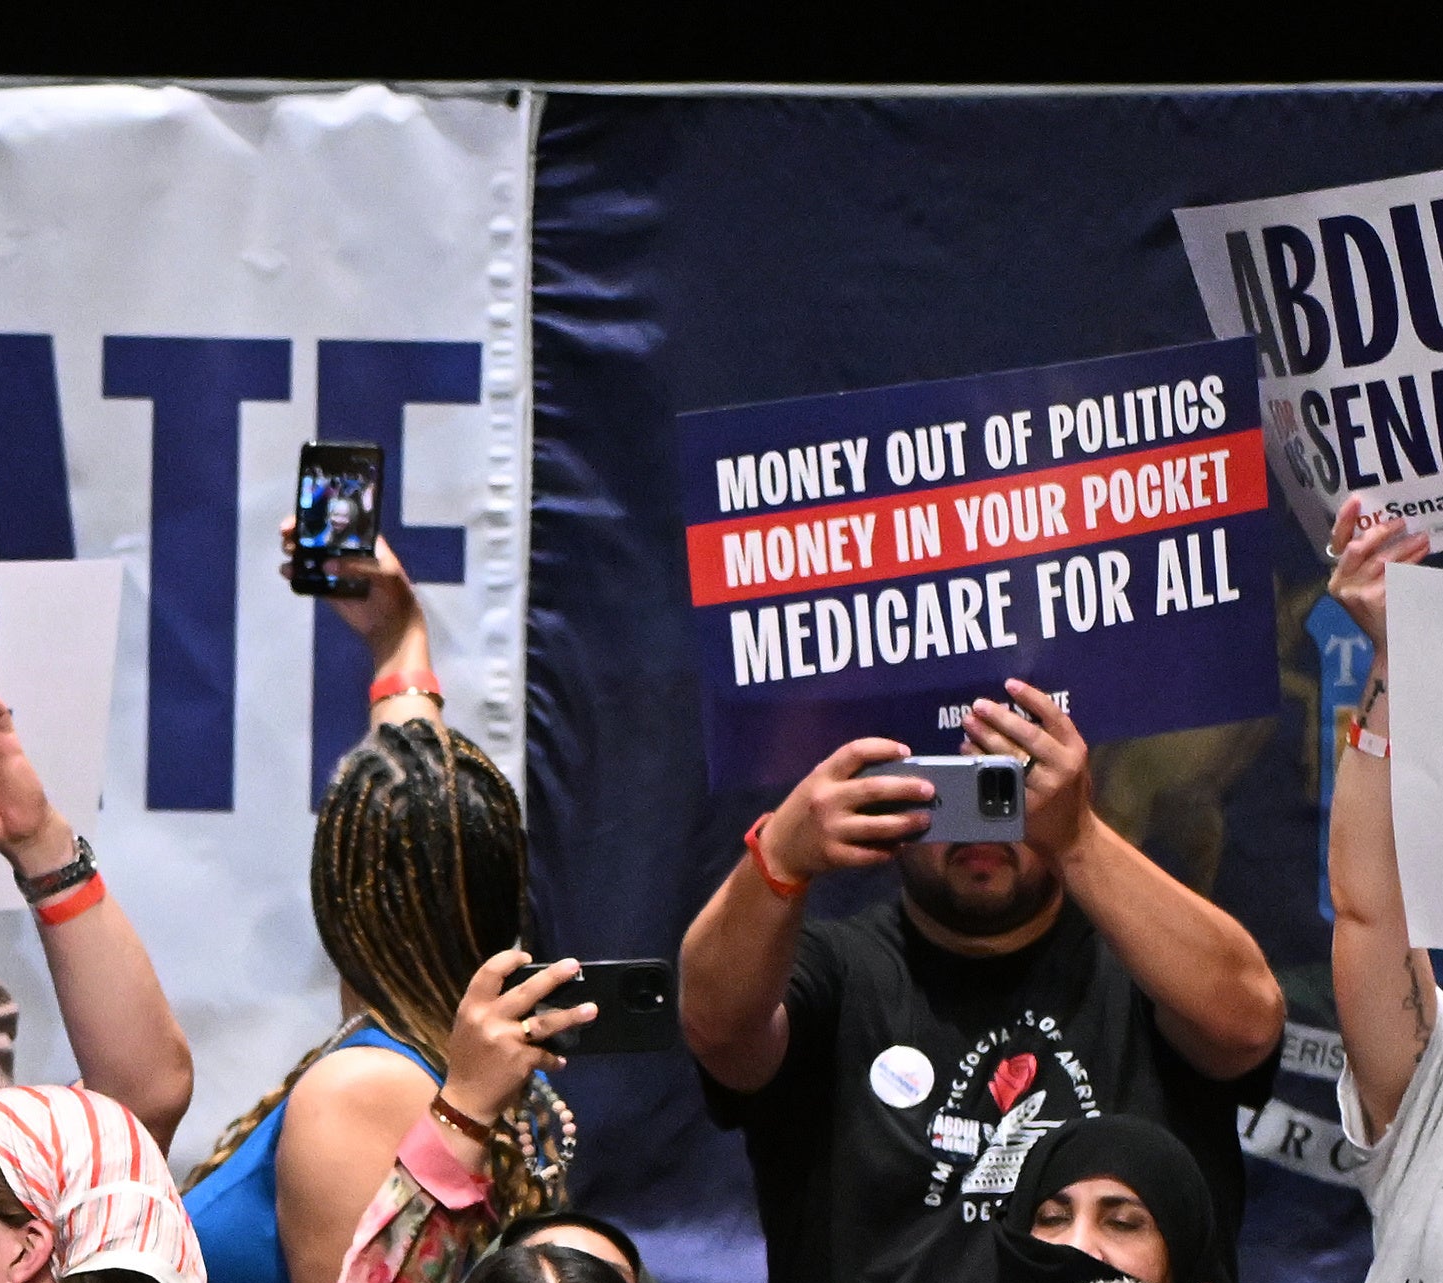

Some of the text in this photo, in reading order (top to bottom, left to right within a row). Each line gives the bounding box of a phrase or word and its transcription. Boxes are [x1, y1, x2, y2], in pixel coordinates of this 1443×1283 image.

[716, 374, 1227, 513] MONEY OUT OF POLITICS
[722, 450, 1232, 589] MONEY IN YOUR POCKET
[730, 528, 1241, 687] MEDICARE FOR ALL
